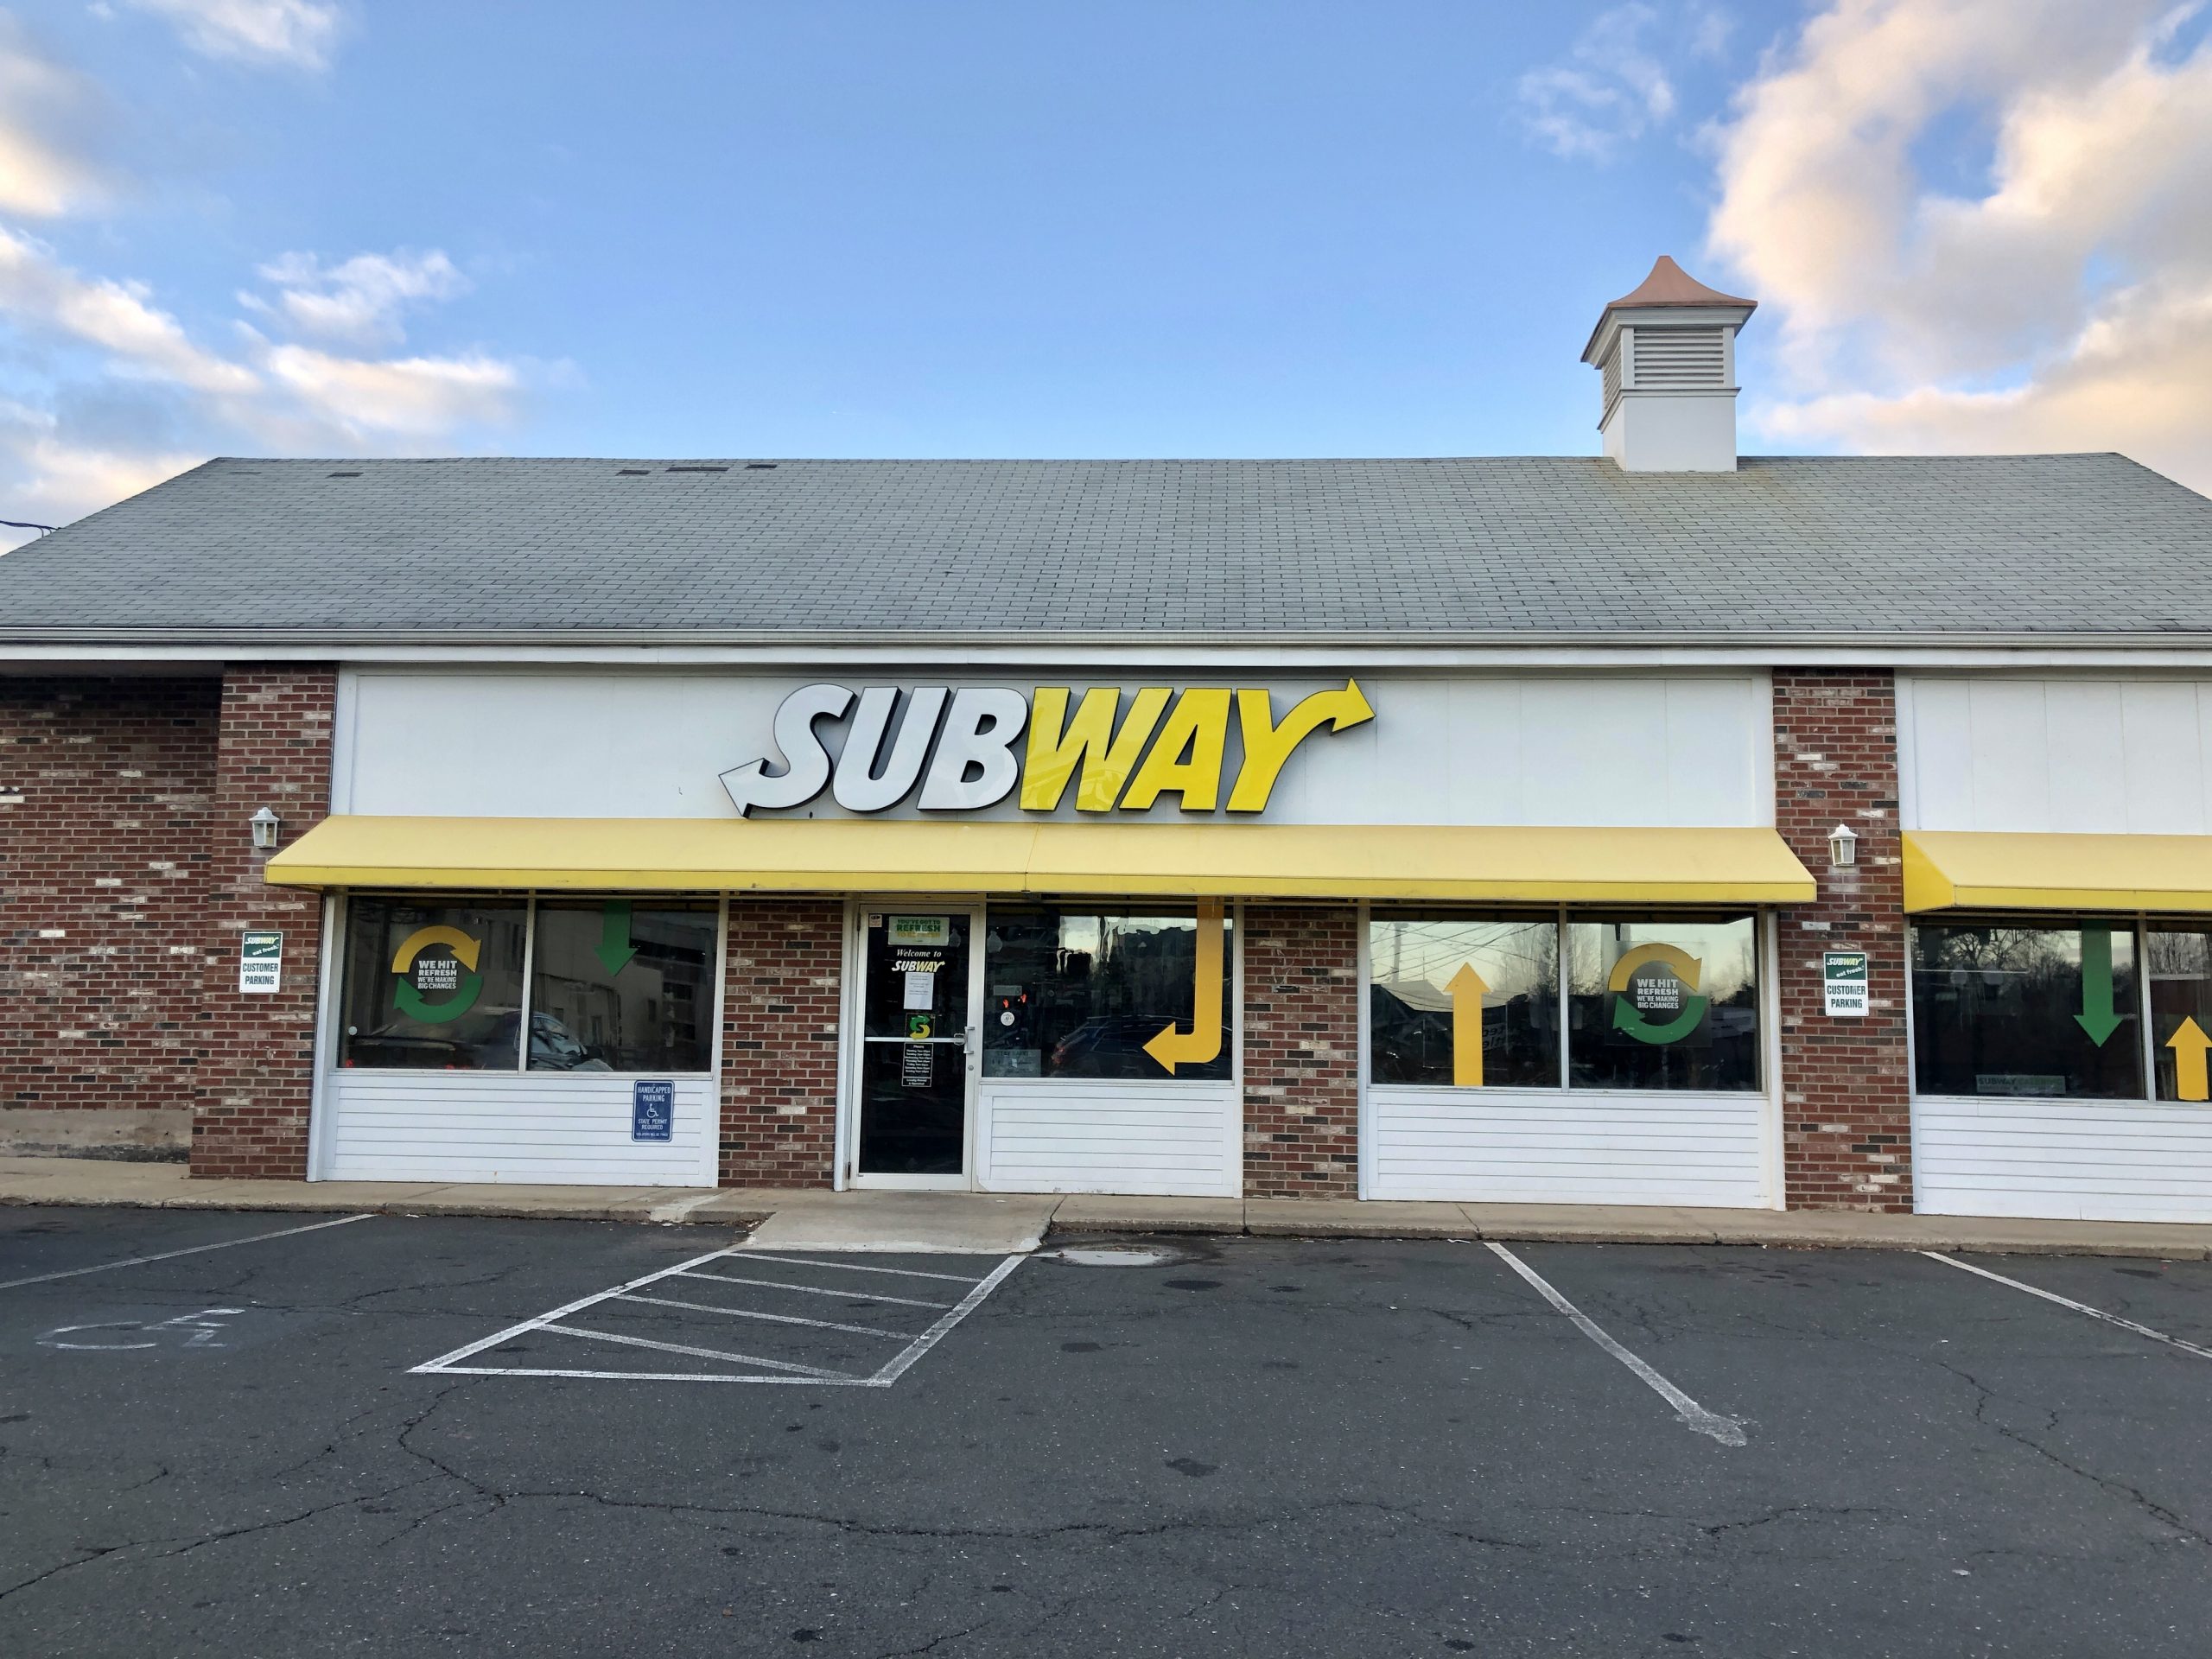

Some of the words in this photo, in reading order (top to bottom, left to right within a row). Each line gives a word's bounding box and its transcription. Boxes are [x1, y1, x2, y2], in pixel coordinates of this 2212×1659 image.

[718, 676, 1376, 818] SUBWAY
[897, 949, 931, 957] Welcome
[418, 960, 436, 969] WE
[438, 960, 457, 969] HIT
[1827, 957, 1863, 966] SUBWAY
[243, 963, 279, 973] CUSTOMER
[891, 961, 945, 973] SUBWAY
[245, 976, 275, 985] PARKING
[1637, 979, 1656, 988] WE
[1657, 979, 1678, 988] HIT
[1827, 985, 1866, 995] CUSTOMER
[1831, 998, 1863, 1008] PARKING
